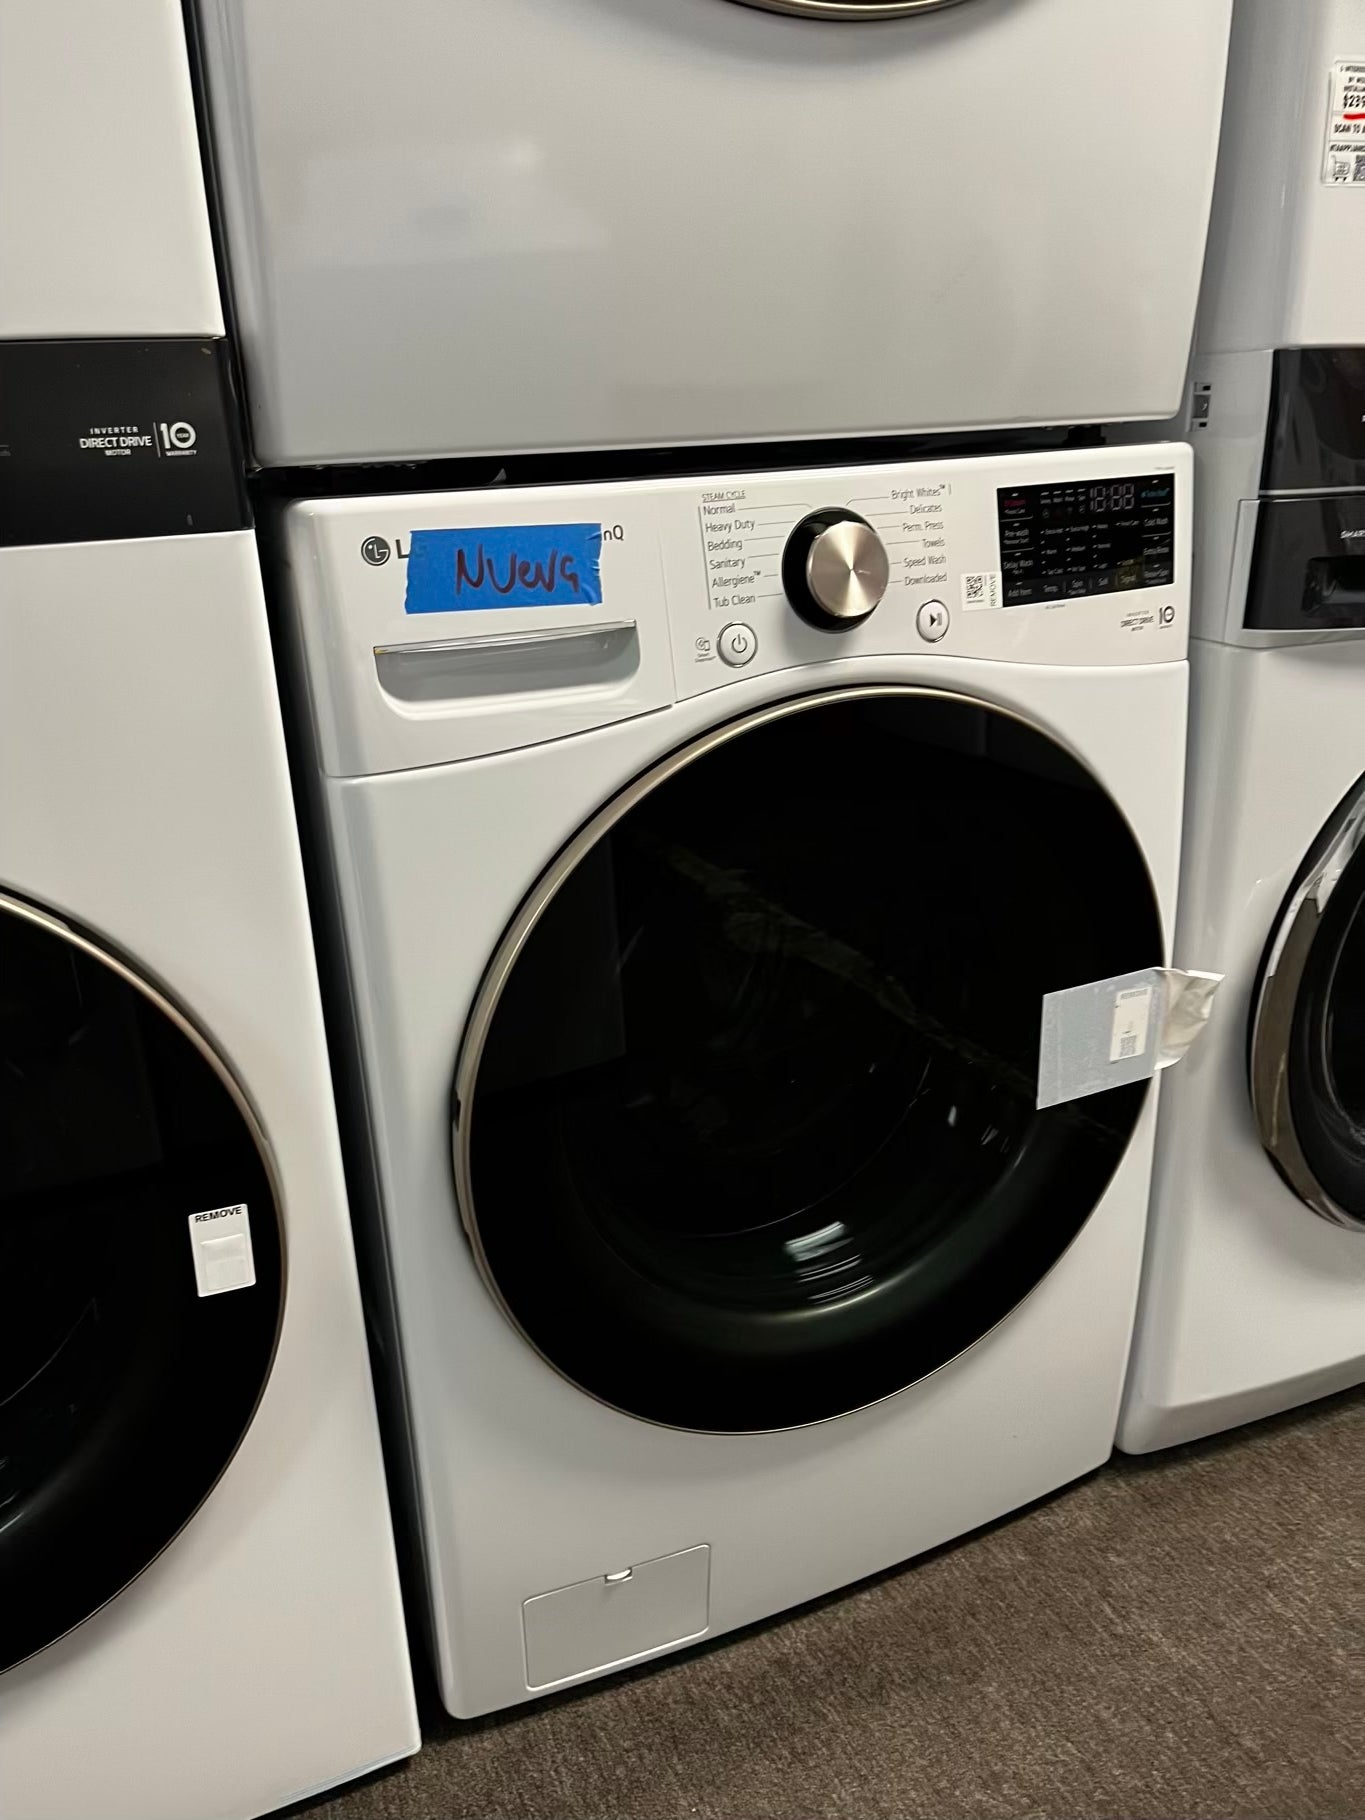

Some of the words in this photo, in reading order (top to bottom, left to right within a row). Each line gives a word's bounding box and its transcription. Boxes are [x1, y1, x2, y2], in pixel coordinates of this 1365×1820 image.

[90, 427, 138, 435] INVERTER
[80, 437, 118, 449] DIRECT
[119, 435, 153, 447] DRIVE
[104, 448, 132, 456] MOTOR
[701, 492, 724, 503] STEAM
[703, 503, 735, 516] Normal
[705, 522, 732, 534] Heavy
[733, 518, 755, 531] Duty
[707, 540, 743, 552] Bedding
[922, 537, 946, 549] Towels
[709, 558, 745, 570] Sanitary
[928, 554, 947, 565] Wash
[904, 573, 947, 586] Downloaded
[712, 596, 730, 608] Tub
[731, 593, 756, 606] Clean
[195, 1206, 242, 1223] REMOVE
